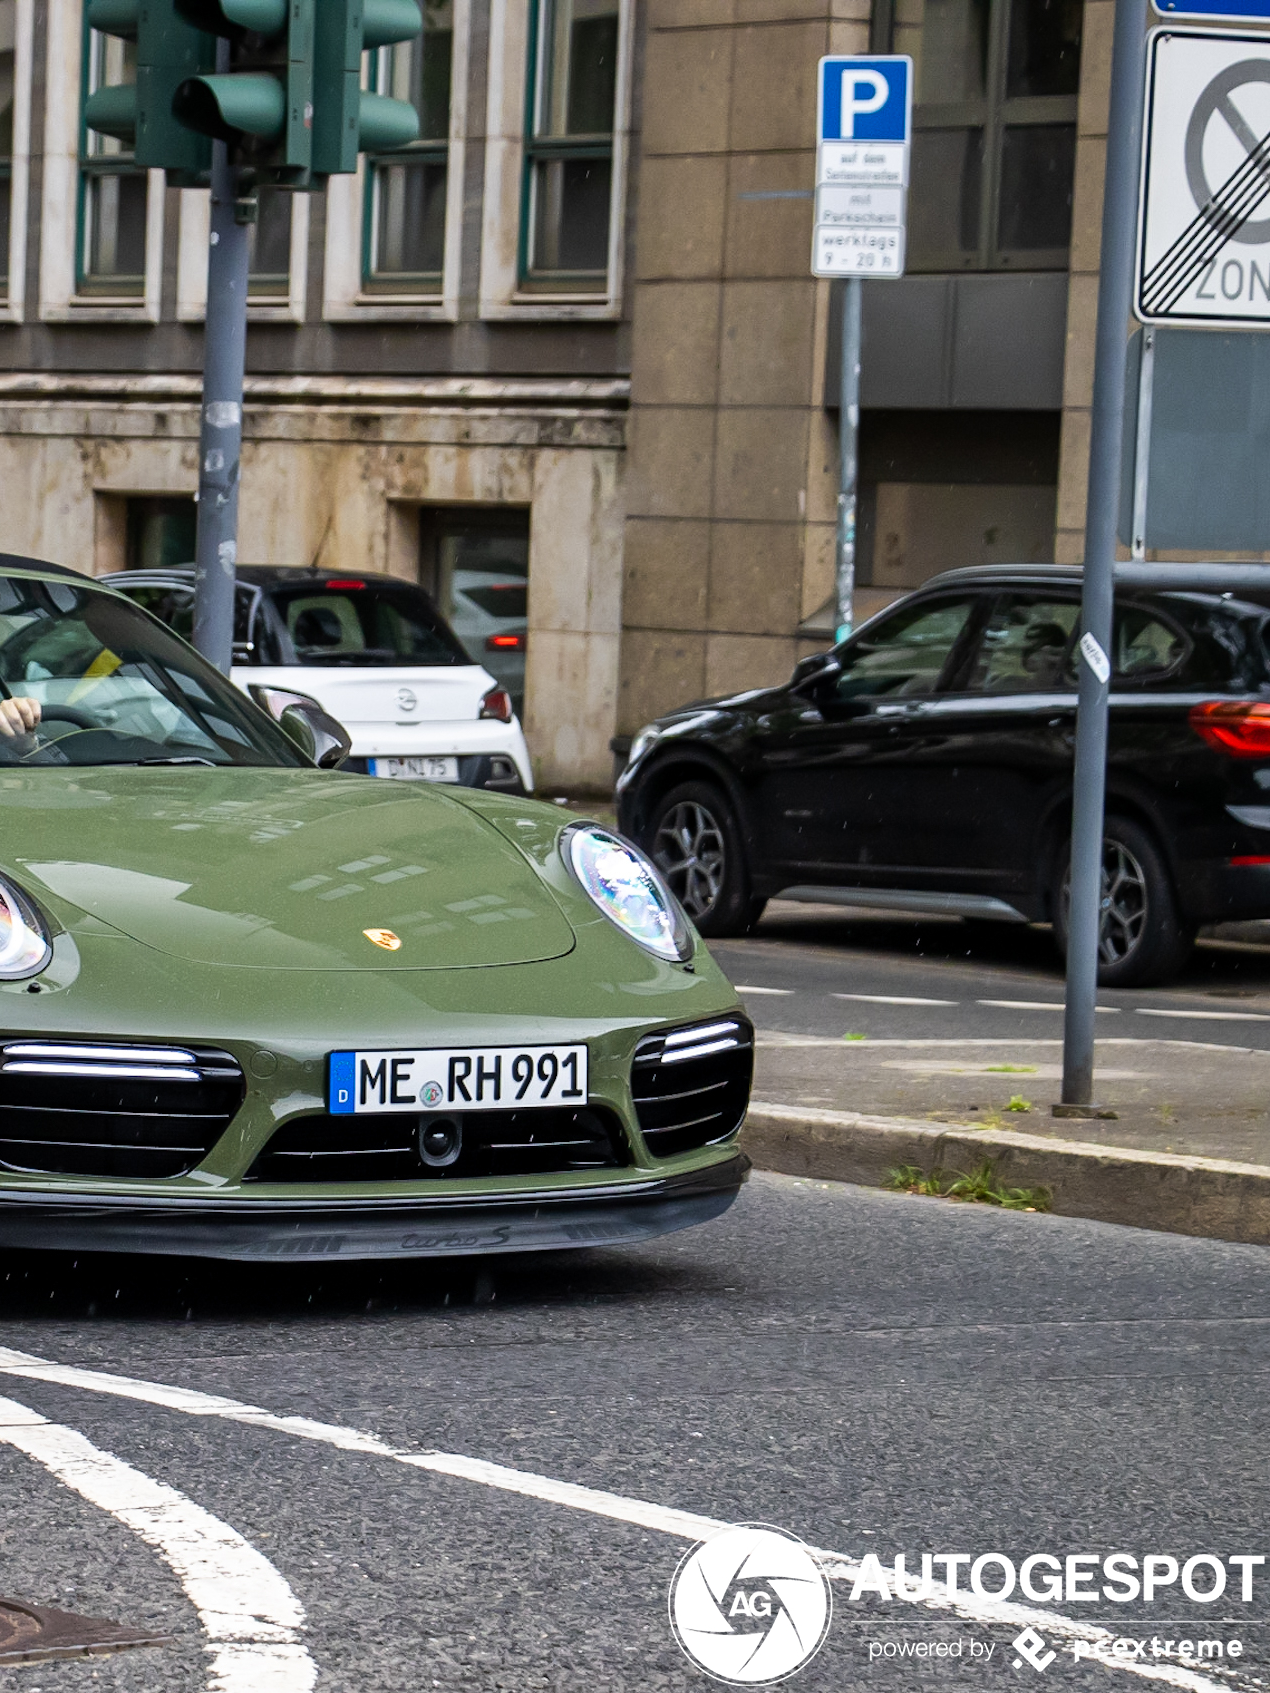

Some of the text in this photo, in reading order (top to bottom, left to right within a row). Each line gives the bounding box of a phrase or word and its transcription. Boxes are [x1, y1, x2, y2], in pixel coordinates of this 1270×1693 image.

[840, 69, 889, 139] P
[841, 152, 857, 163] auf
[823, 234, 896, 250] werktags
[825, 252, 833, 265] 9
[856, 252, 874, 267] 20
[360, 1051, 583, 1105] ME RH 991
[339, 1089, 348, 1103] D
